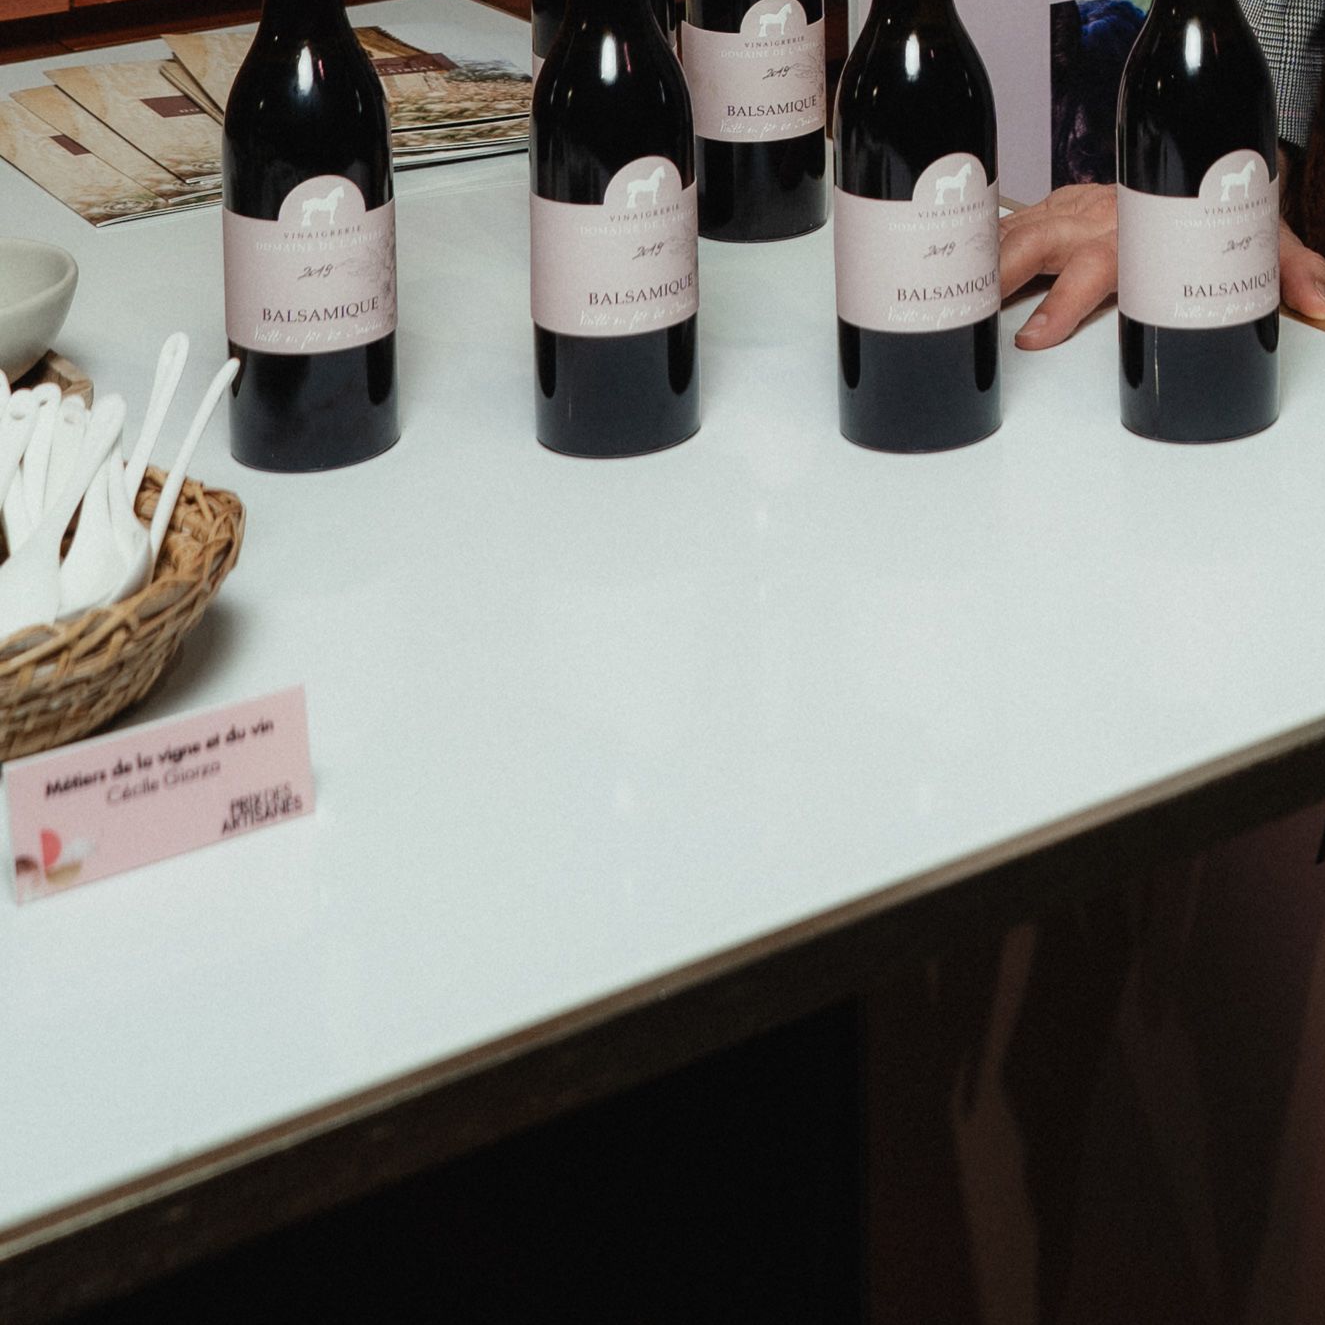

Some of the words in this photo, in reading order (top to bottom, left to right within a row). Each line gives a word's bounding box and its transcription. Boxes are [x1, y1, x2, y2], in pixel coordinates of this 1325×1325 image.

[727, 94, 817, 117] BALSAMIQUE
[588, 272, 694, 306] BALSAMIQUE
[897, 269, 998, 302] BALSAMIQUE
[1182, 266, 1278, 298] BALSAMIQUE
[262, 296, 380, 323] BALSAMIQUE
[45, 770, 107, 798] Métiers
[112, 758, 133, 777] de
[136, 752, 153, 769] la
[158, 743, 201, 763] vigne
[206, 733, 220, 749] et
[225, 723, 246, 743] du
[251, 718, 275, 735] vin
